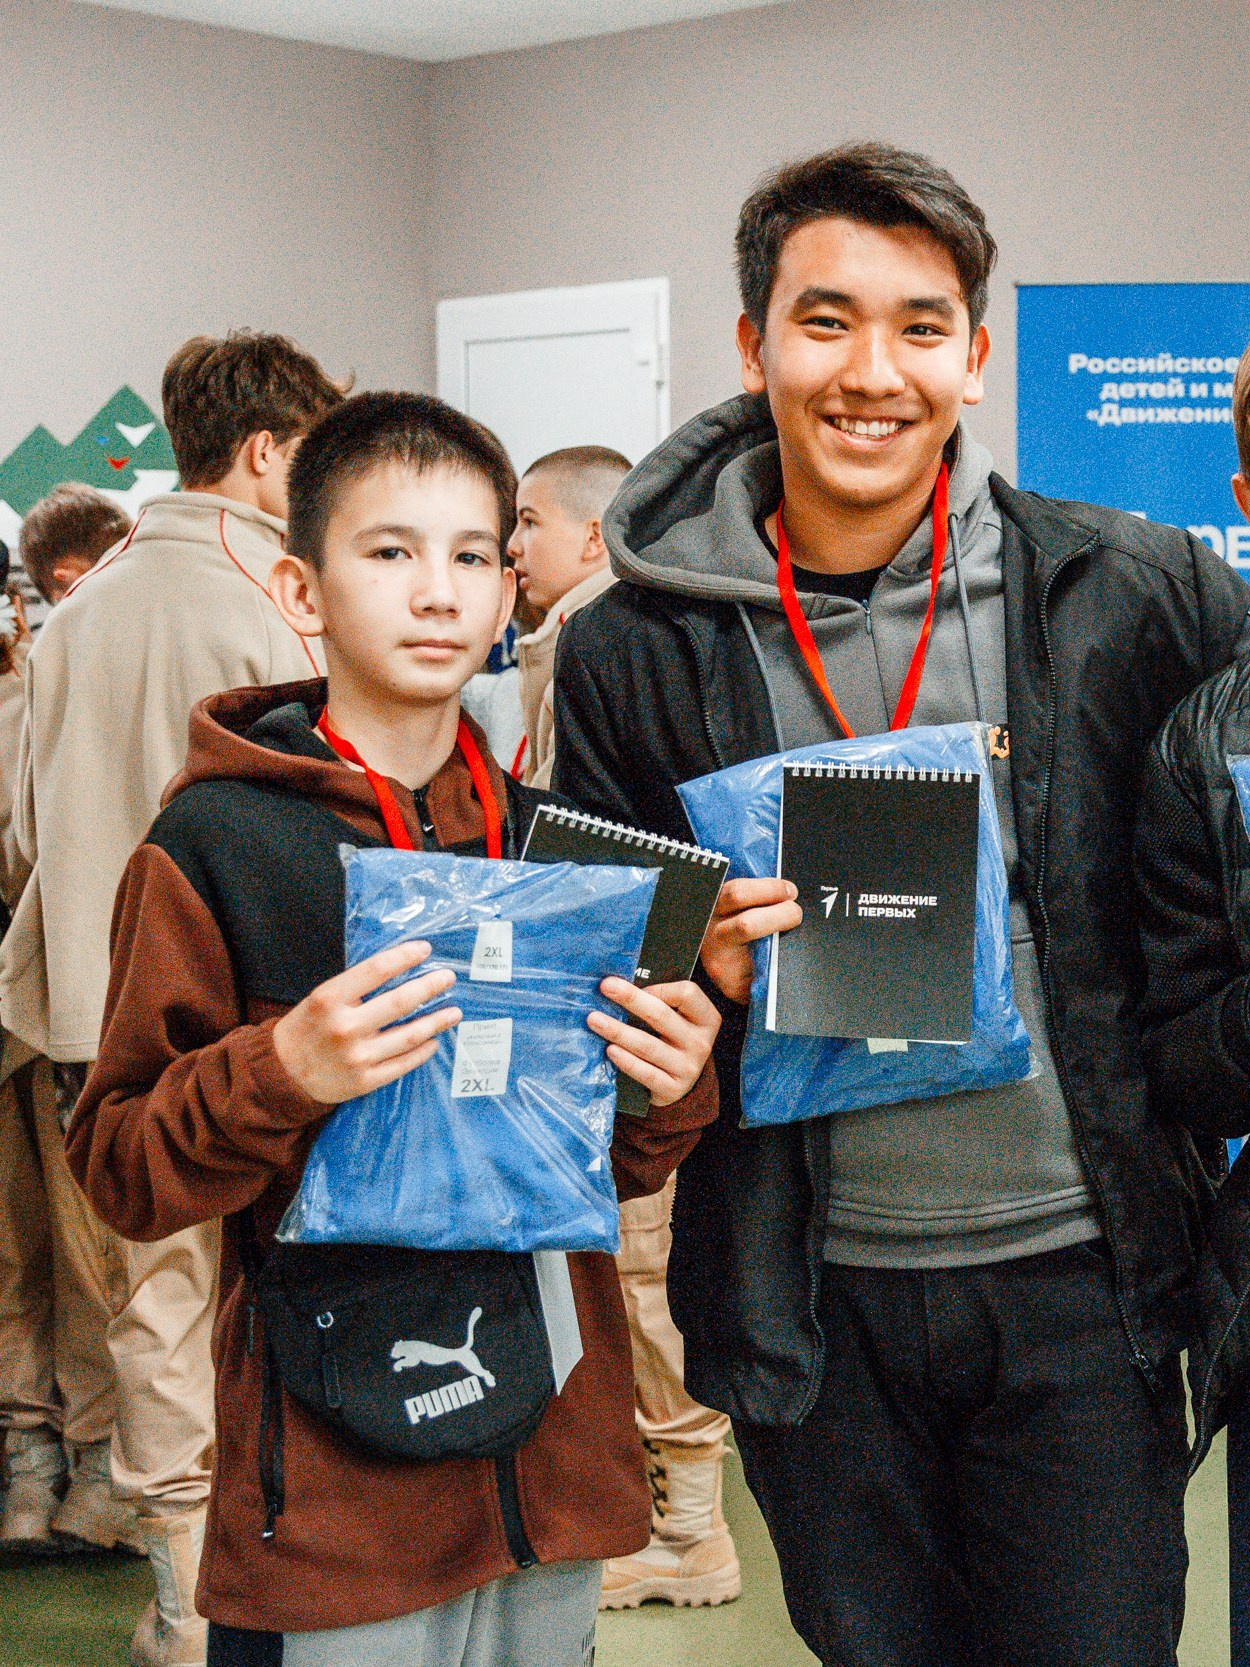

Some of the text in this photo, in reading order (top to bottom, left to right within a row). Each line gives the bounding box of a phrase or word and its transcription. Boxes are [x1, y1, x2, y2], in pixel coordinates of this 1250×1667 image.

[1099, 377, 1185, 402] детей
[1189, 382, 1209, 399] и
[1086, 402, 1234, 427] «Движени
[857, 893, 938, 906] ДВИЖЕНИЕ
[857, 906, 917, 919] ПЕРВЫХ
[484, 945, 503, 958] 2XL
[460, 1078, 496, 1094] 2XL
[404, 1374, 486, 1425] PUMA
